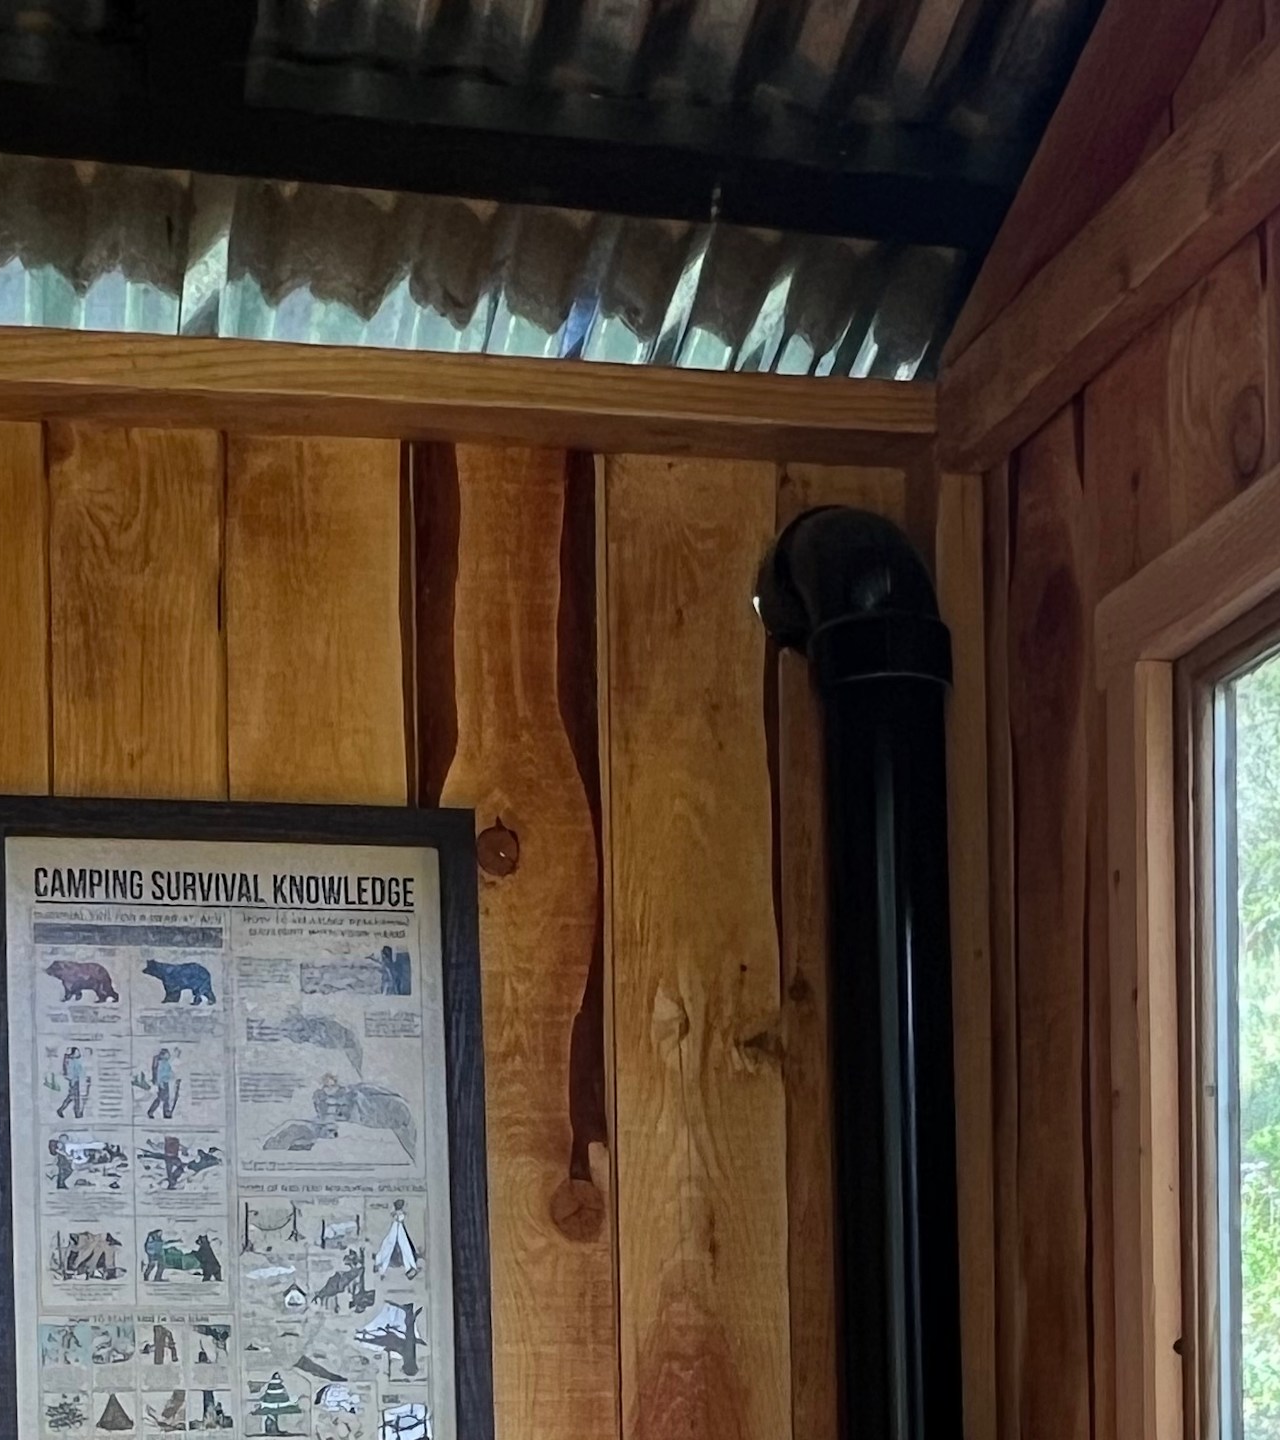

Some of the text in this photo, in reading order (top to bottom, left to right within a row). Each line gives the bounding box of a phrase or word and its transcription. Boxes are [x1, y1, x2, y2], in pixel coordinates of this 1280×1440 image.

[34, 867, 414, 907] CAMPING SURVIVAL KNOWLEDGE
